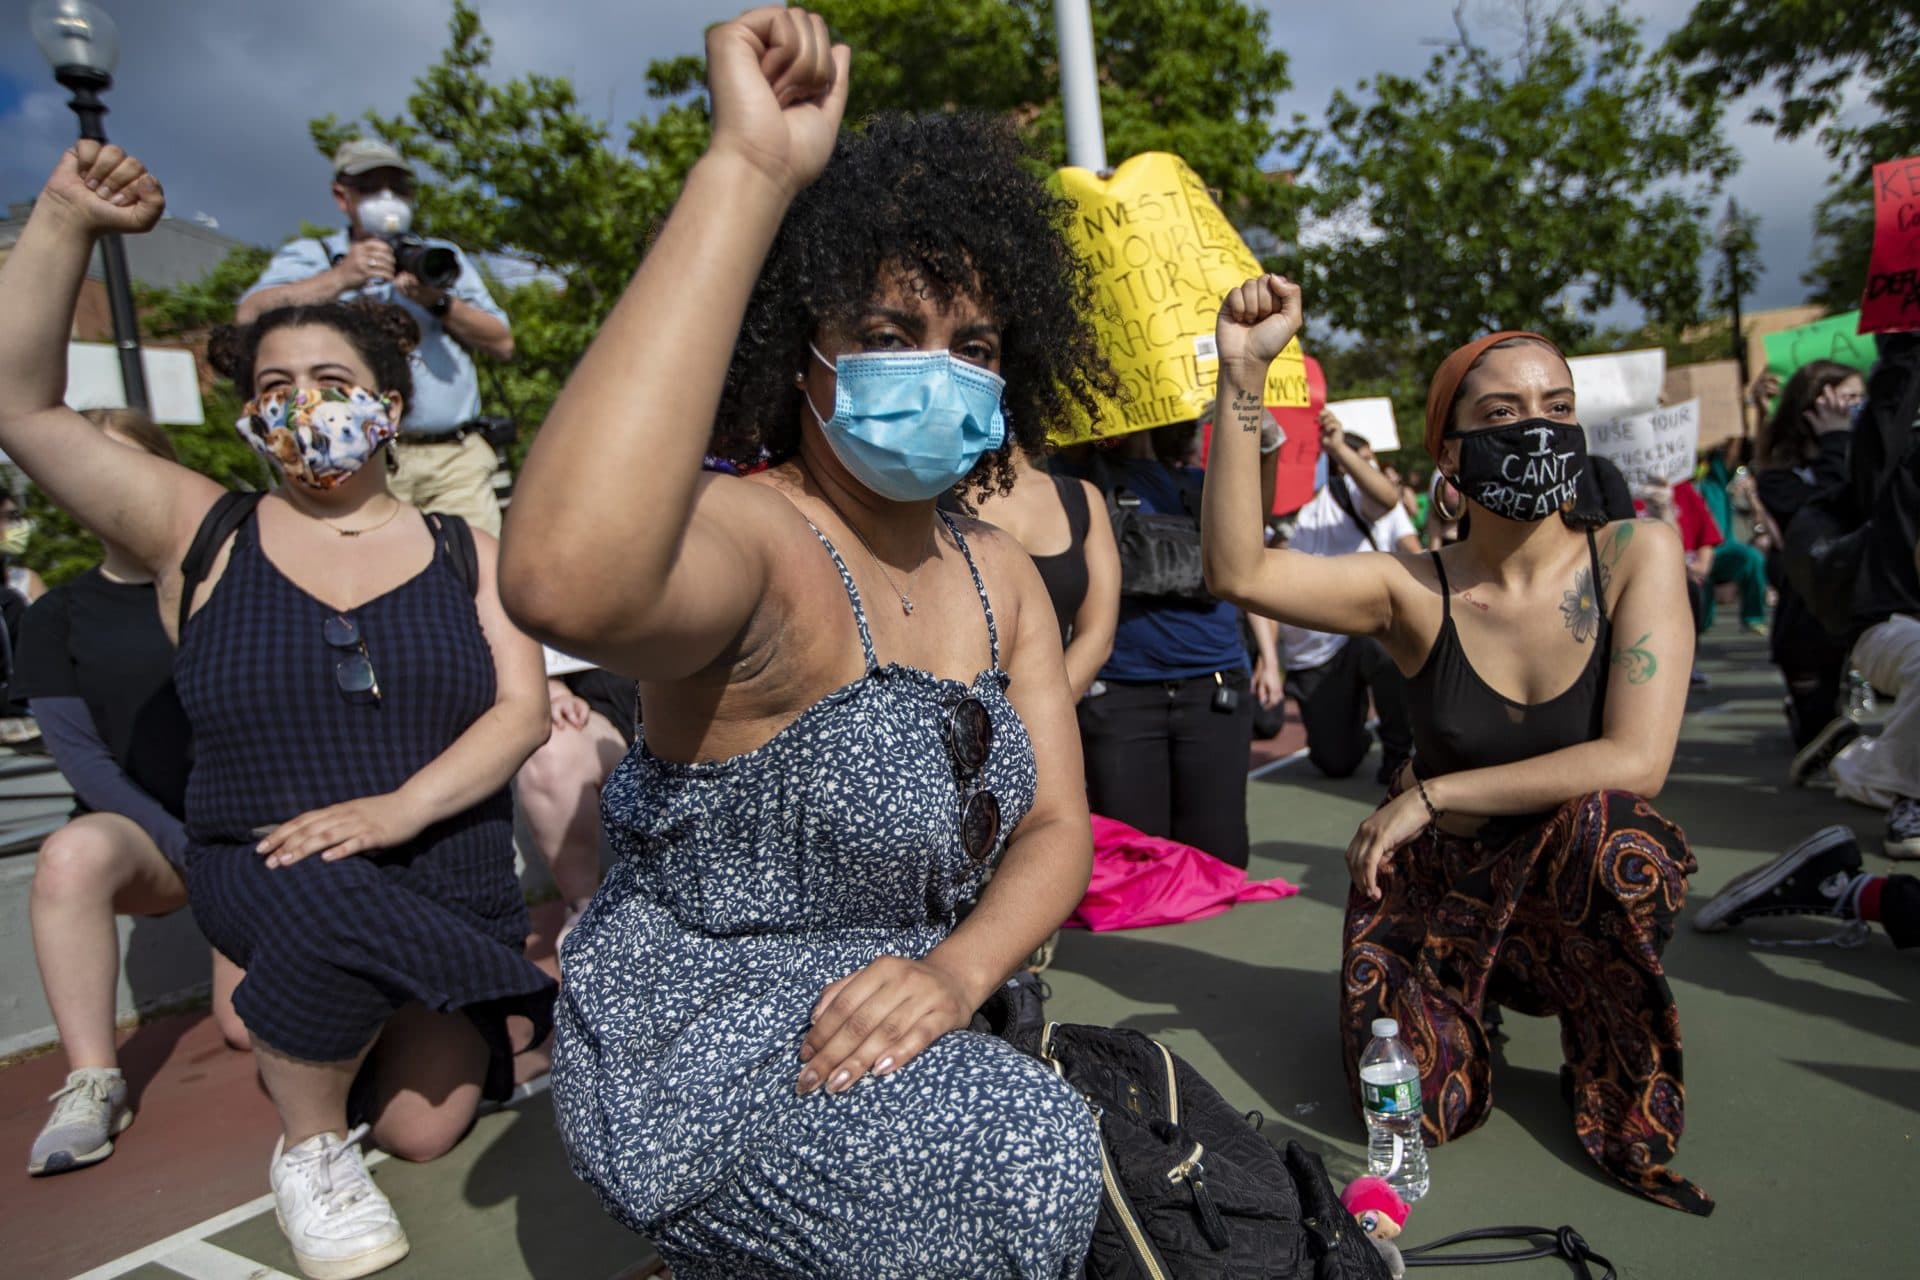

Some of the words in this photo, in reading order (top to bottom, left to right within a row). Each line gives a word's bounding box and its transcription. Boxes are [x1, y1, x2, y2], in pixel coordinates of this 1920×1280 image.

[1081, 191, 1179, 240] NVEST
[1122, 224, 1202, 268] OUR
[1096, 255, 1217, 310] UTURE
[1099, 295, 1225, 358] RACIS
[1119, 354, 1218, 401] SYSTE
[1524, 427, 1554, 456] I
